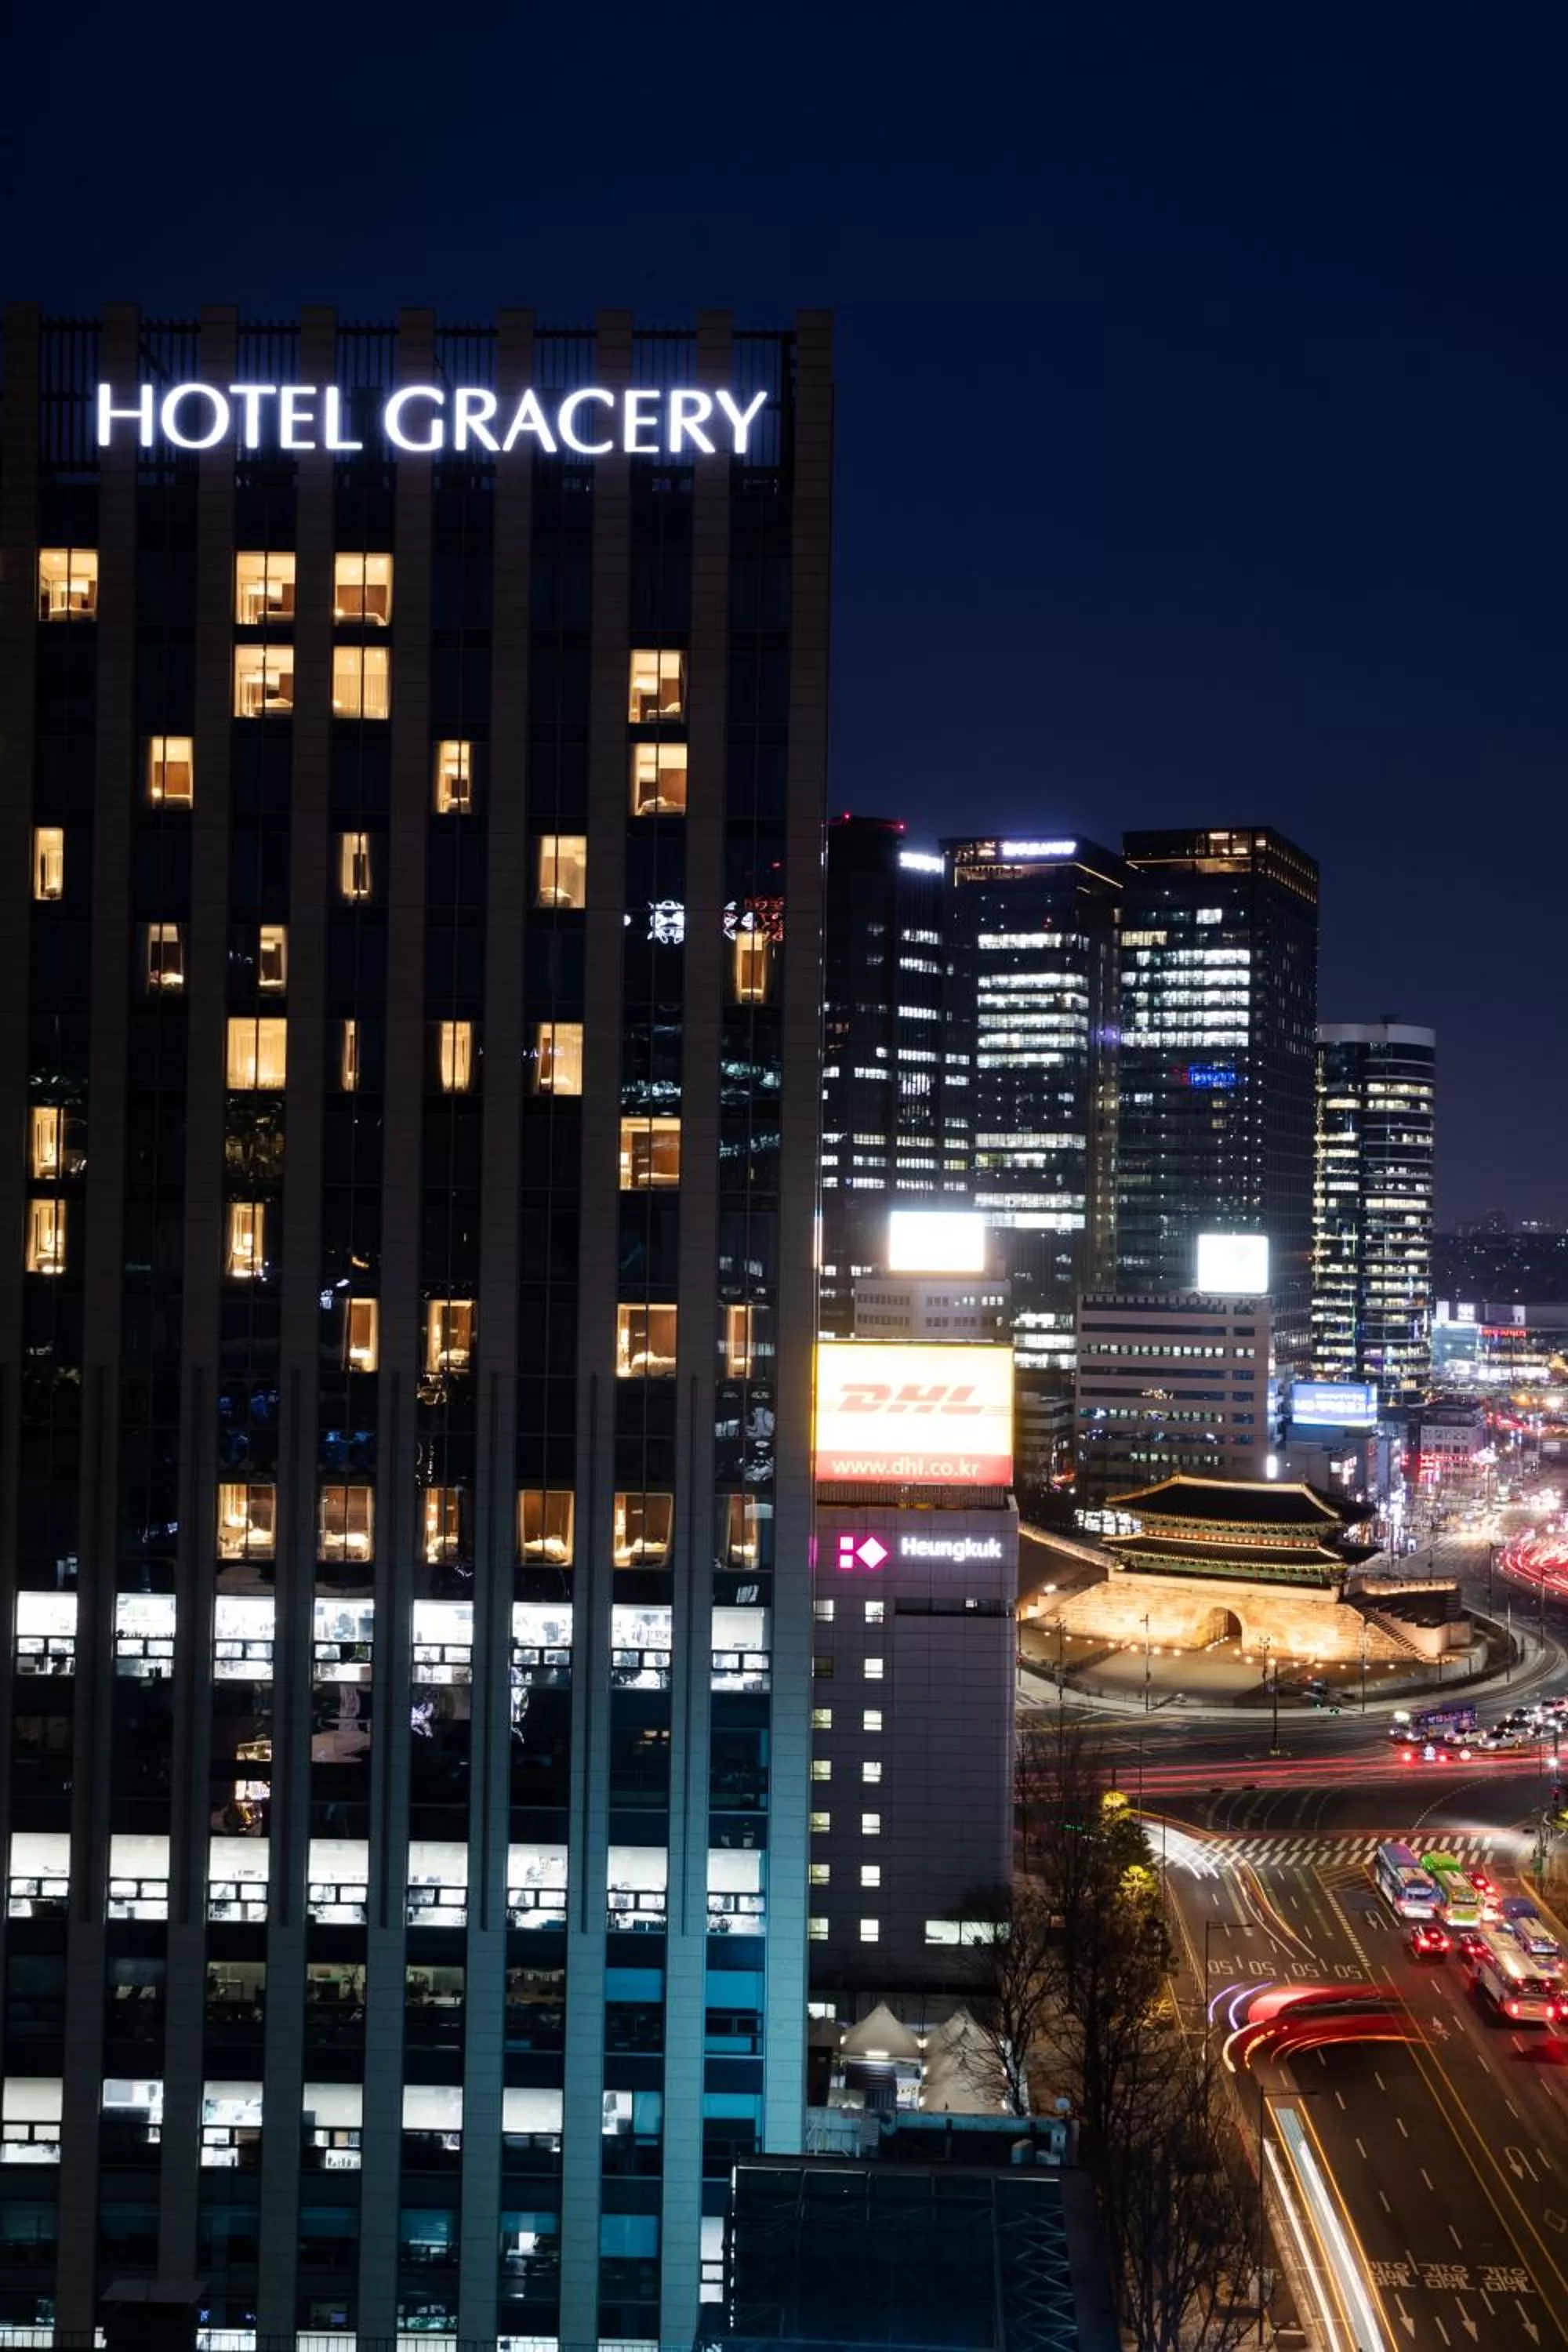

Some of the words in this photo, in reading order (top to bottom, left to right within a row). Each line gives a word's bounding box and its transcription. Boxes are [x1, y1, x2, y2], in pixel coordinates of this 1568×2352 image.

[96, 383, 363, 450] HOTEL
[383, 385, 768, 455] GRACERY
[837, 1383, 985, 1414] DHL
[832, 1456, 980, 1477] www.dhl.co.kr
[901, 1537, 1002, 1562] Heungkuk
[1207, 1960, 1234, 1975] 50
[1249, 1961, 1277, 1976] 50
[1291, 1962, 1320, 1978] 50
[1334, 1964, 1363, 1980] 50
[1417, 2263, 1476, 2290] 광화문
[1477, 2266, 1537, 2293] 광화문
